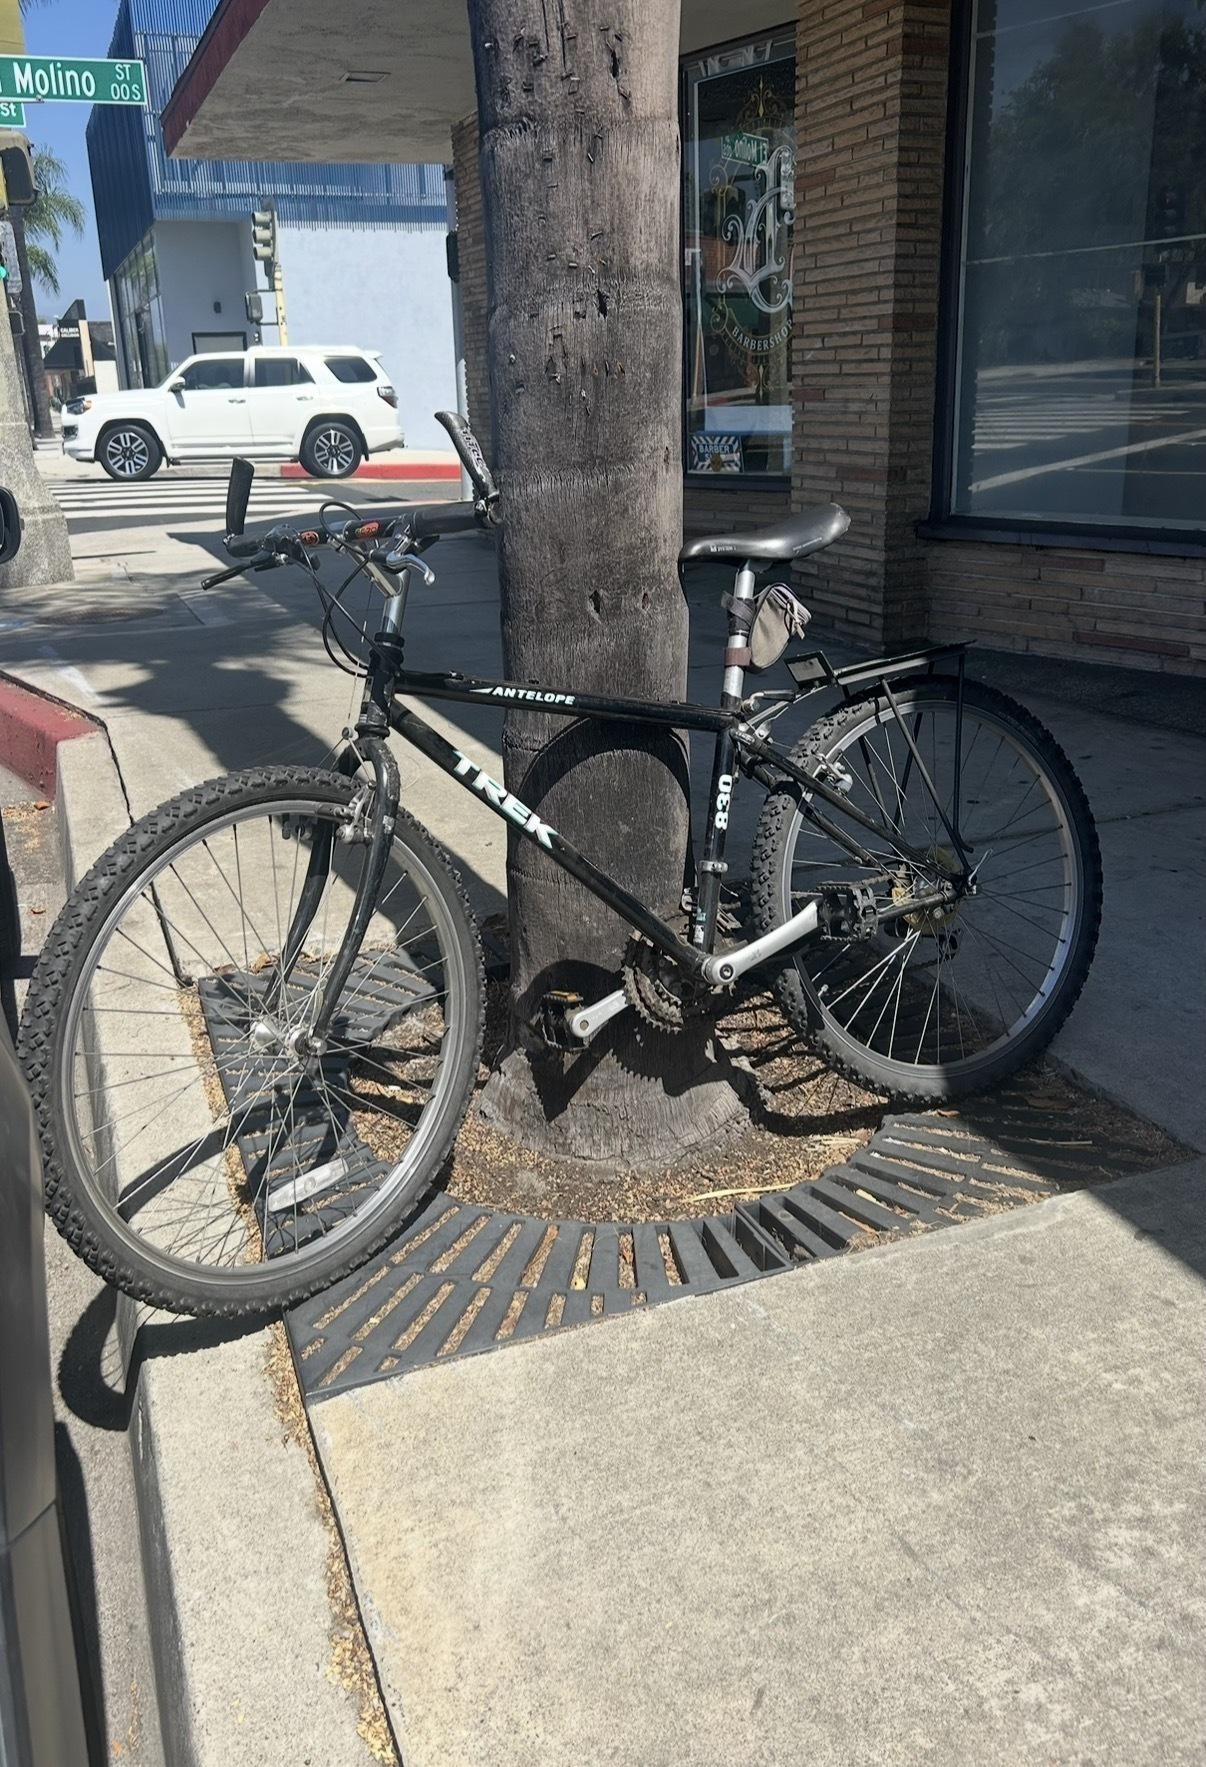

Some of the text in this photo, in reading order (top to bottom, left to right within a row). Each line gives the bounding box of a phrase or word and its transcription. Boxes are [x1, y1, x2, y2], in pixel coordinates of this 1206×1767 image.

[13, 62, 96, 97] Molino
[115, 64, 131, 81] ST
[0, 102, 17, 117] St
[732, 319, 793, 350] BARBERSHOP
[699, 444, 730, 454] BARBER
[492, 686, 576, 705] ANTELOPE
[453, 750, 560, 849] TREK
[715, 774, 734, 830] 830
